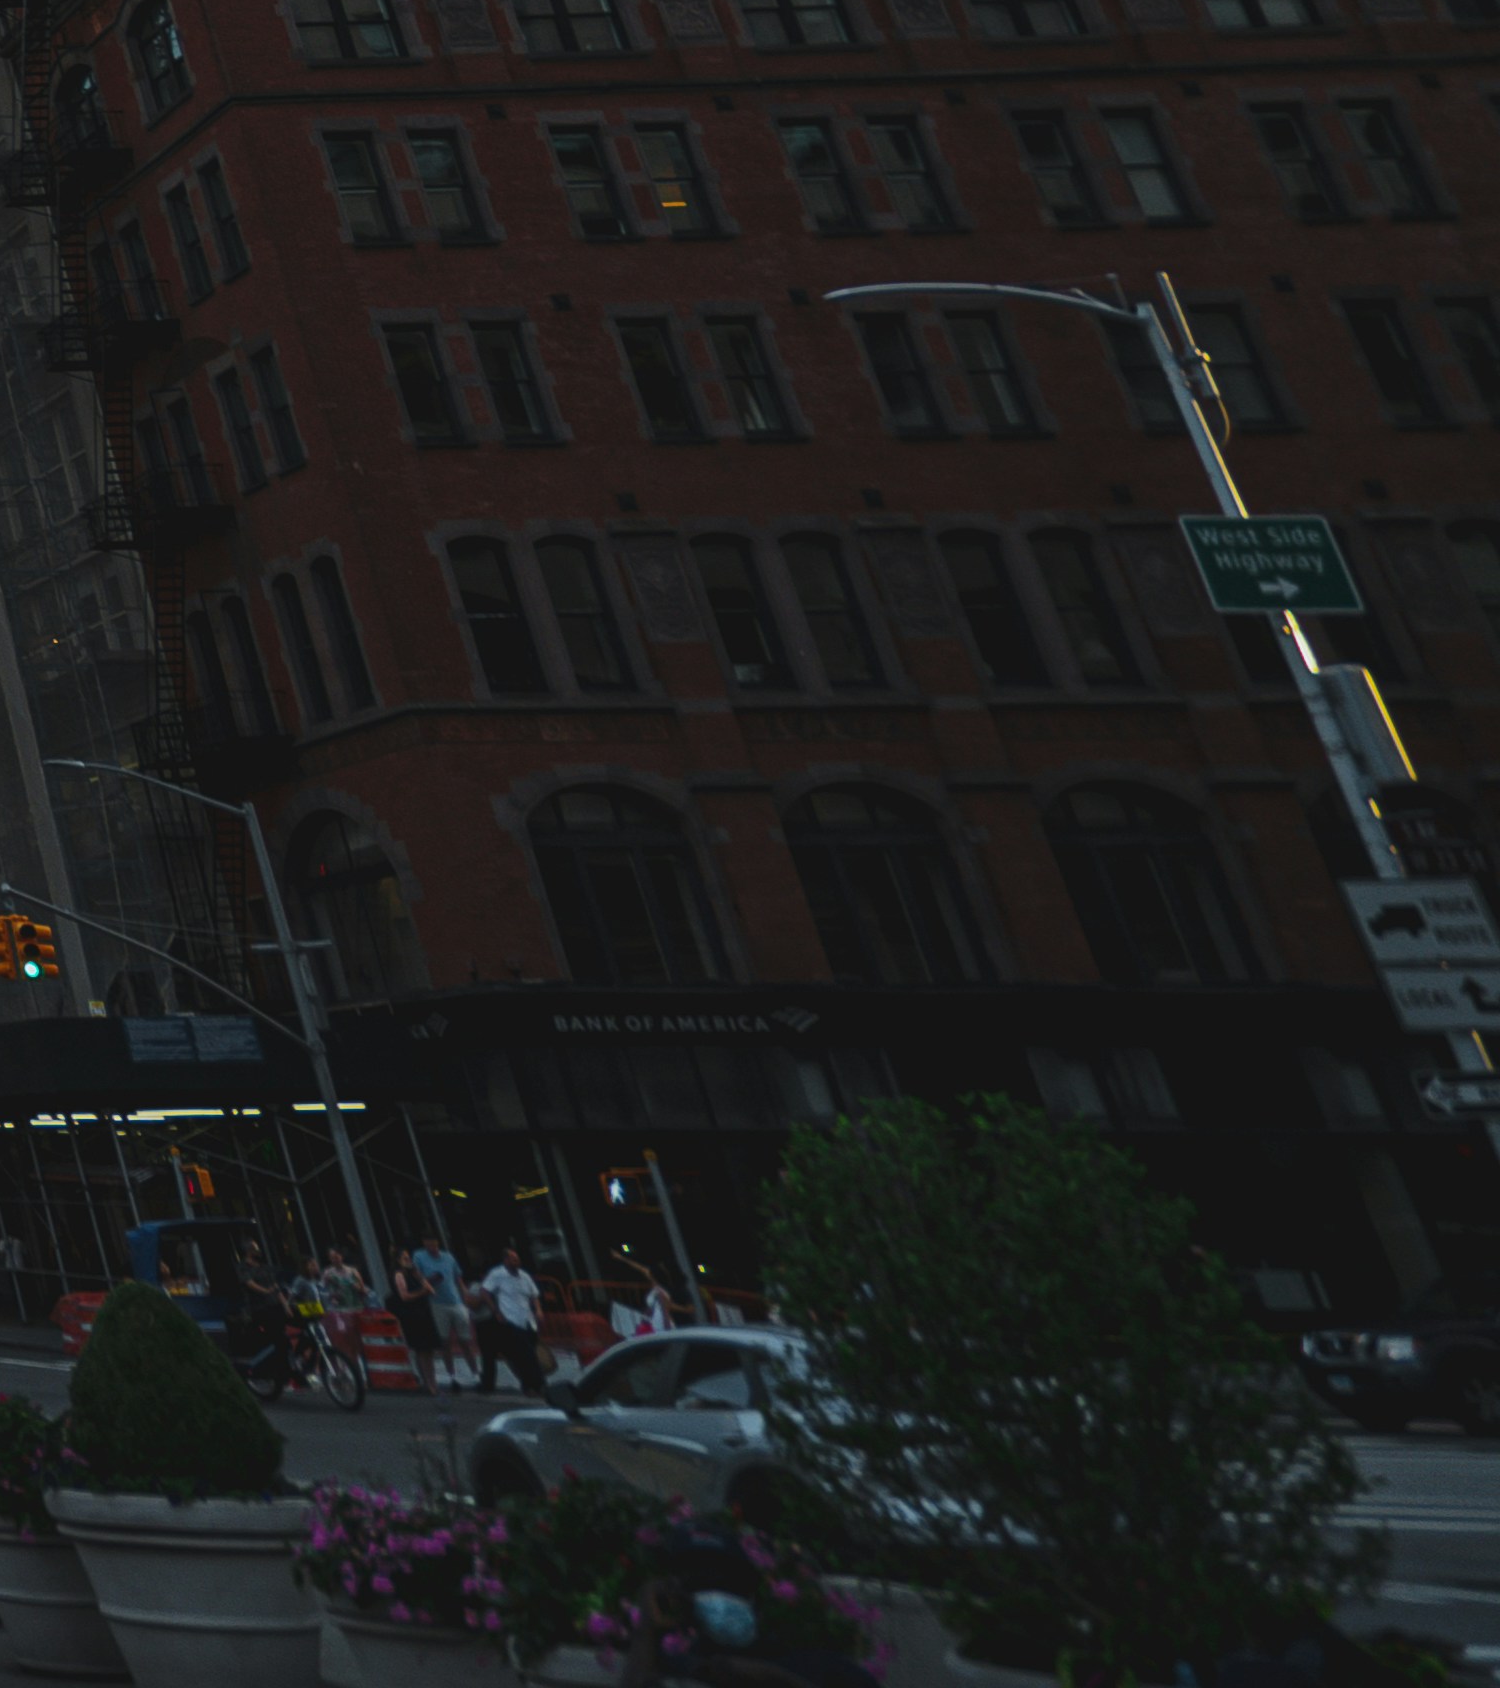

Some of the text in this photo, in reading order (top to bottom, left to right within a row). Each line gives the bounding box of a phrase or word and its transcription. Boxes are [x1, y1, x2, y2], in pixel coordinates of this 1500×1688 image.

[1195, 525, 1324, 547] West Side
[1213, 551, 1325, 576] Highway
[1421, 896, 1478, 914] TRUCK
[1434, 924, 1493, 945] ROUTE
[1396, 987, 1456, 1009] LOCAL
[553, 1015, 771, 1033] BANK OF AMERICA
